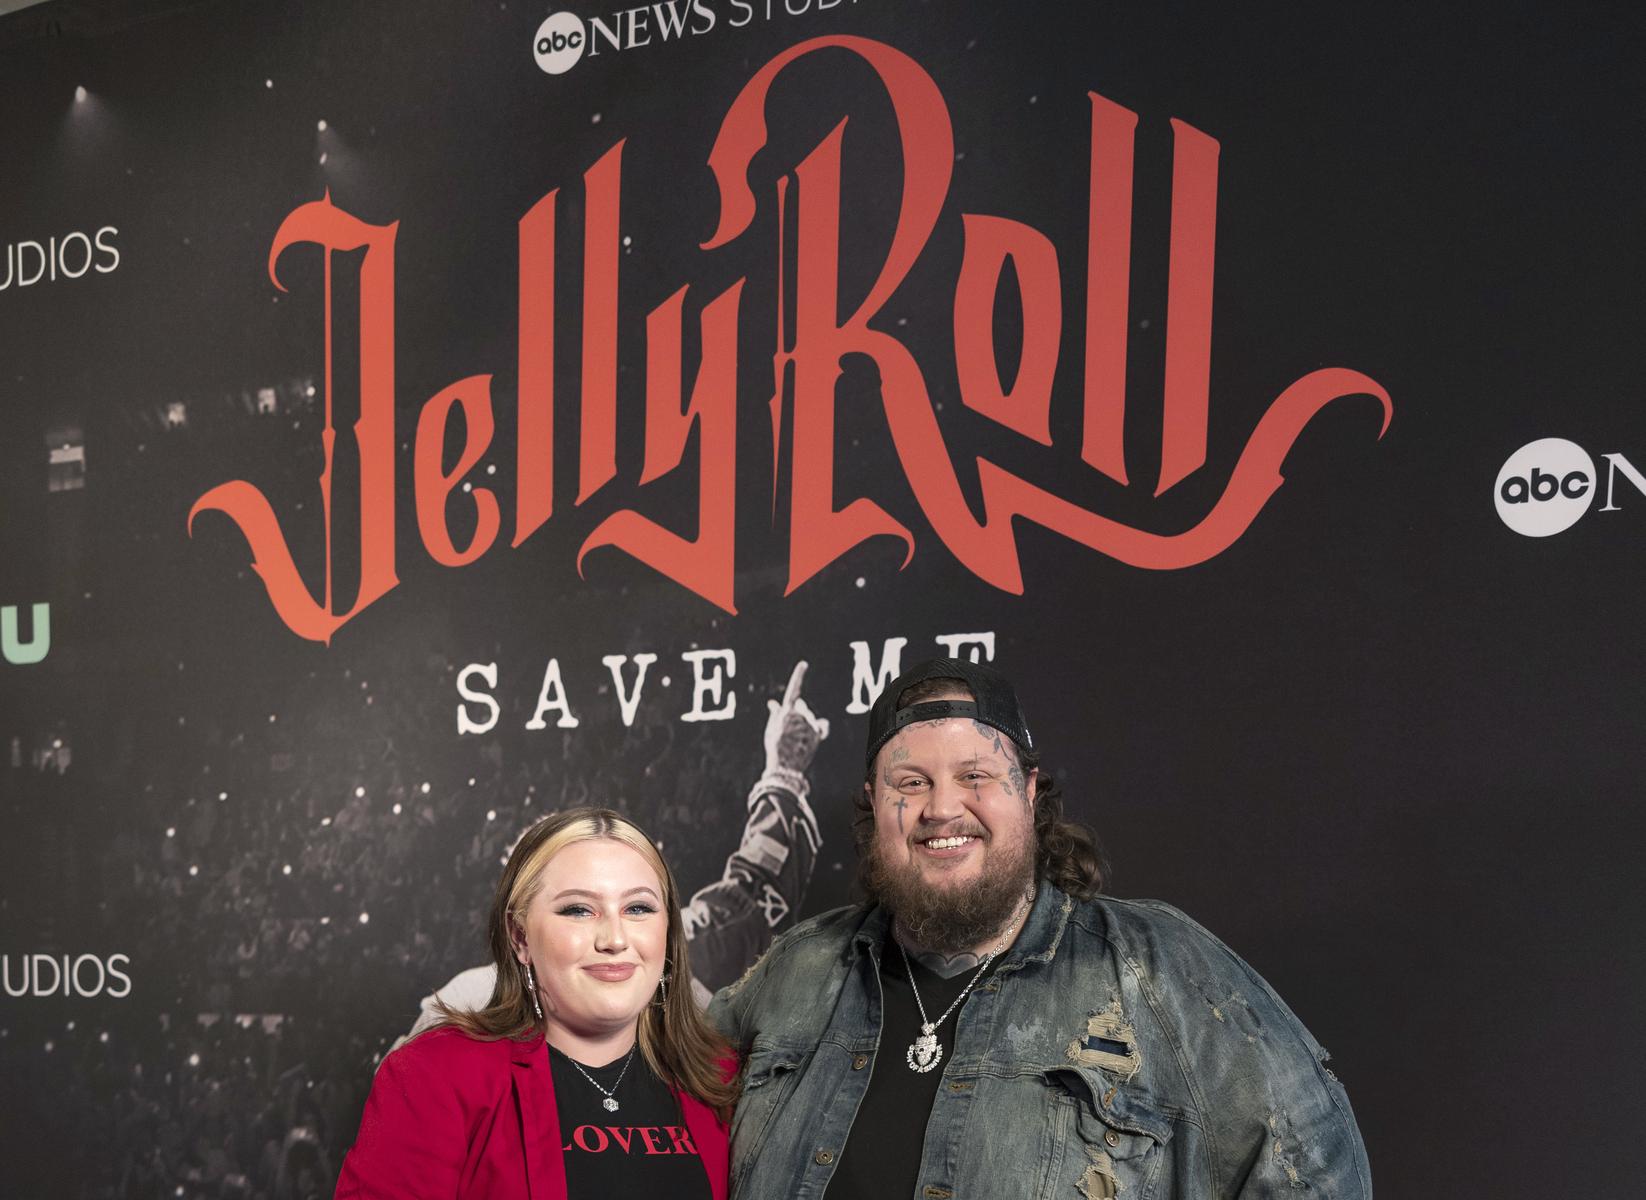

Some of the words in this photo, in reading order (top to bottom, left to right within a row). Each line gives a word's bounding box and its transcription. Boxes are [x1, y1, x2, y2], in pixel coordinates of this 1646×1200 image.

[587, 0, 716, 57] NEWS
[188, 138, 746, 647] Jelly
[700, 35, 1393, 596] Roll
[456, 648, 736, 735] SAVE
